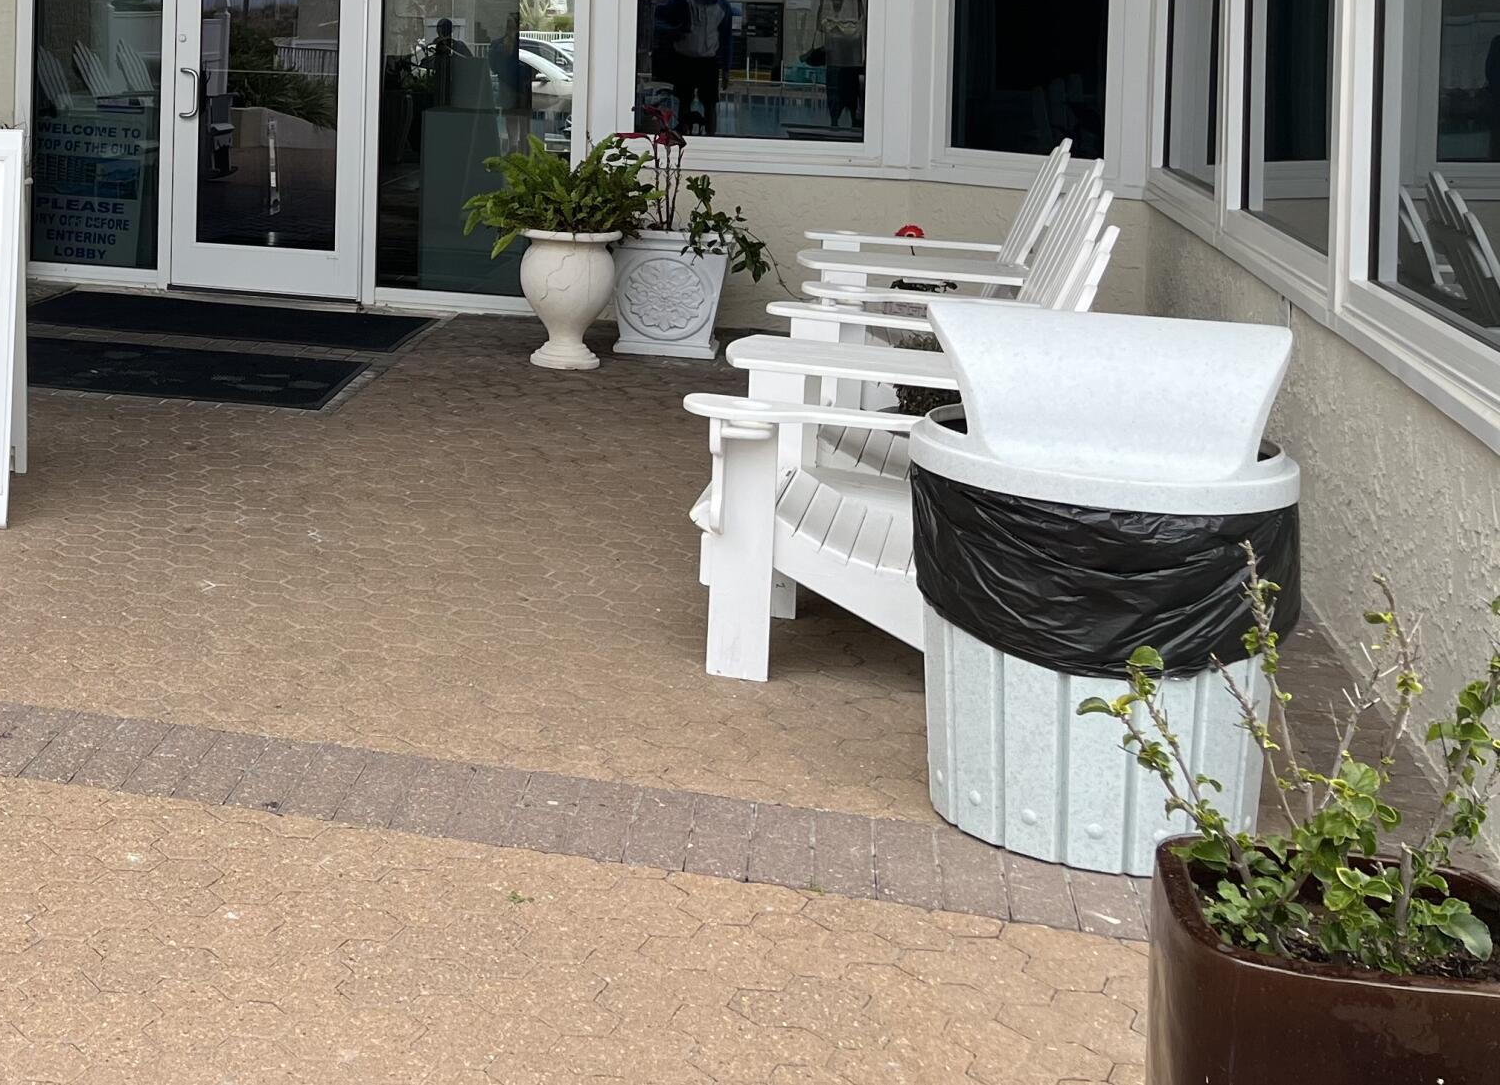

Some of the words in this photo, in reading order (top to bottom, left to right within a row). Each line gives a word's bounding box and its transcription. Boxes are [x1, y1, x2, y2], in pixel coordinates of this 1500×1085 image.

[37, 121, 117, 138] WELCOME
[122, 128, 141, 139] TO
[37, 138, 61, 151] TOP
[64, 140, 80, 152] OF
[84, 142, 108, 154] THE
[111, 144, 141, 156] GULF
[36, 196, 125, 214] PLEASE
[46, 228, 117, 245] ENTERING
[54, 246, 107, 260] LOBBY
